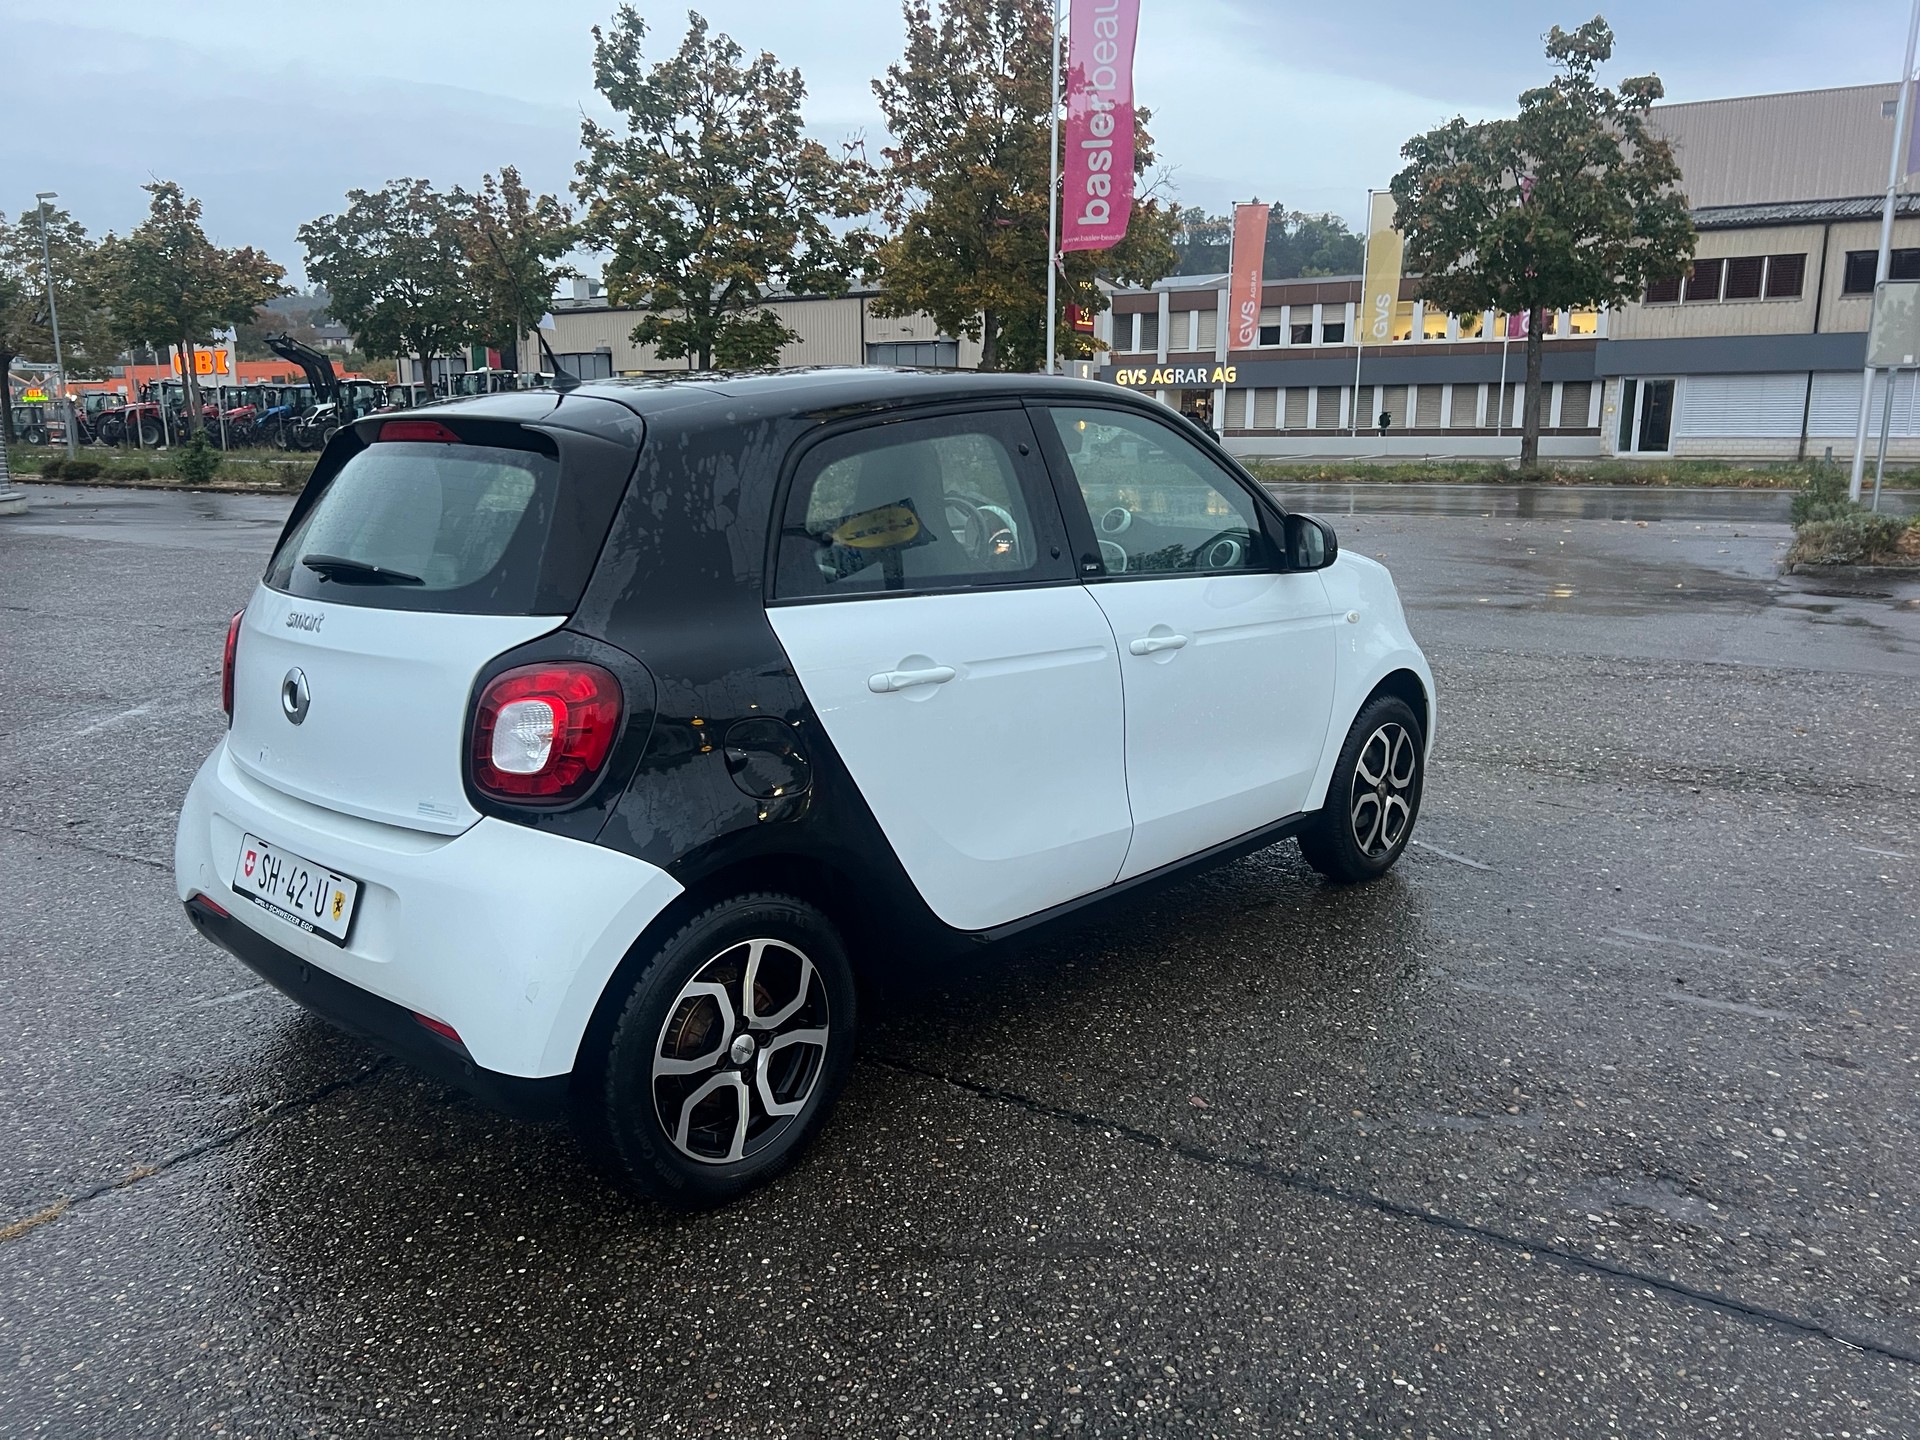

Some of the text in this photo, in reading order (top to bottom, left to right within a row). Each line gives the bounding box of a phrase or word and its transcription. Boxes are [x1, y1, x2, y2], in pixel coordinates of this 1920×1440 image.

[1239, 270, 1258, 343] GVS AGRAR
[1373, 292, 1391, 337] GVS
[173, 350, 230, 375] OBI
[1115, 366, 1237, 385] GVS AGRAR AG
[286, 613, 325, 634] smart
[268, 904, 301, 926] SCHWEIZER
[300, 920, 314, 933] EGG
